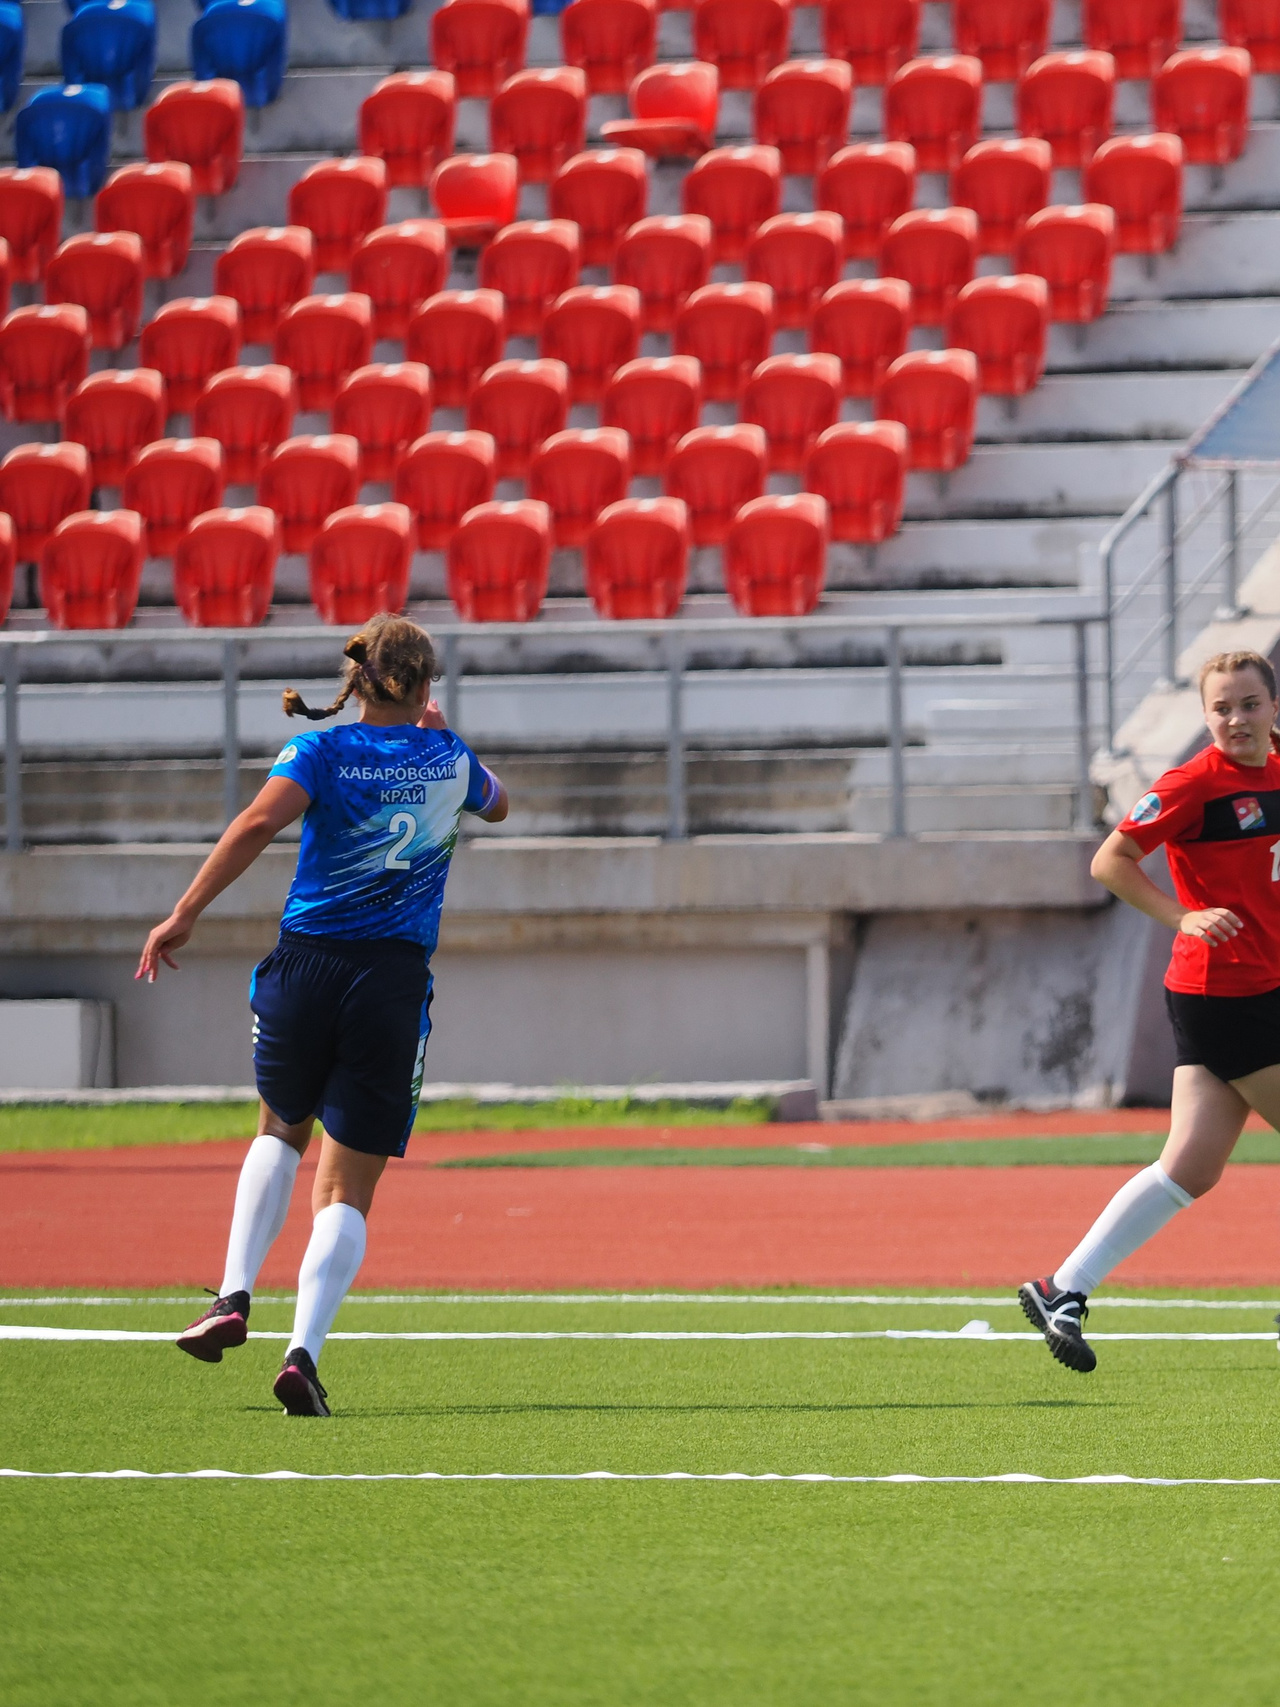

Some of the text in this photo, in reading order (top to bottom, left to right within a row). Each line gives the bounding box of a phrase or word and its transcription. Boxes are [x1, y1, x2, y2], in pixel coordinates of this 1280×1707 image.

[338, 761, 457, 781] ХАБАРОВСКИЙ
[380, 787, 425, 803] КРАЙ
[384, 811, 418, 870] 2
